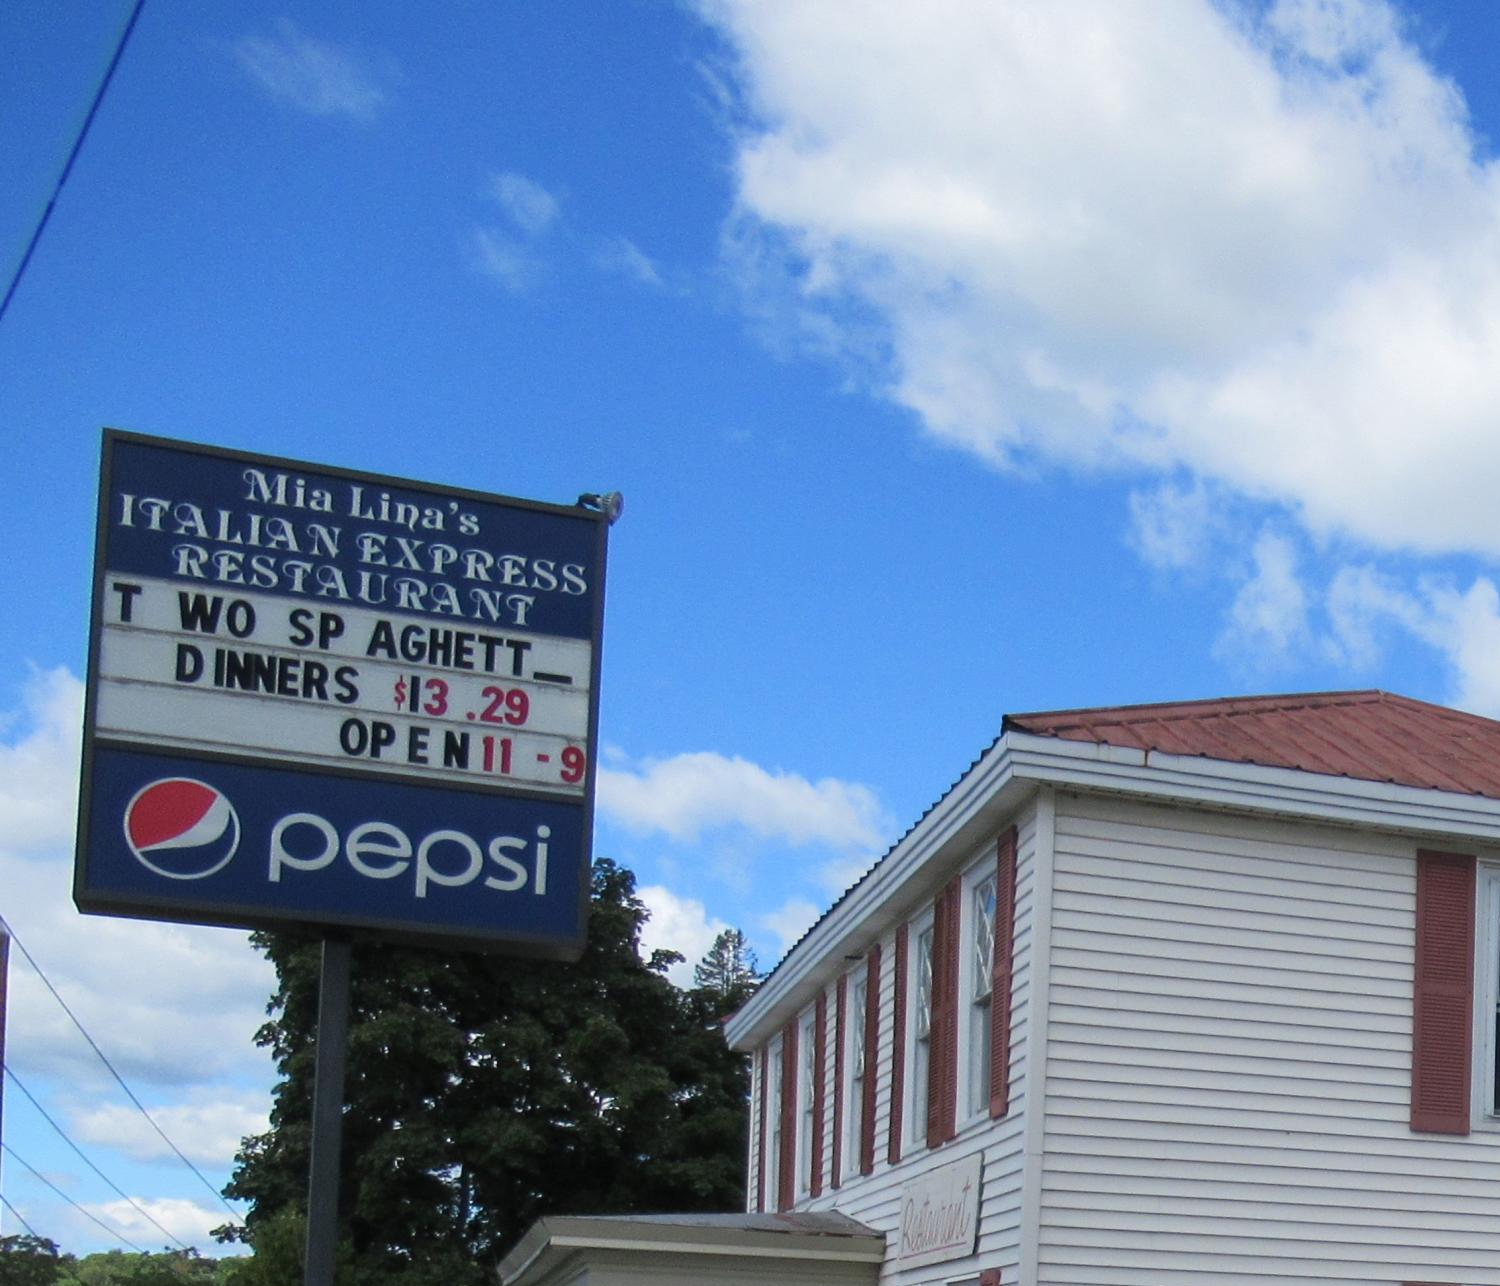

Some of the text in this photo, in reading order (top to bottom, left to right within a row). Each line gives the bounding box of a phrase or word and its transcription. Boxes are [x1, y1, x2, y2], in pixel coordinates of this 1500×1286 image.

[242, 468, 481, 536] Mia Lina's
[118, 493, 589, 597] ITALIAN EXPRESS
[171, 543, 538, 627] RESTAURANT
[175, 642, 360, 705] DINNERS
[339, 716, 470, 769] OPEN
[268, 811, 552, 899] pepsi
